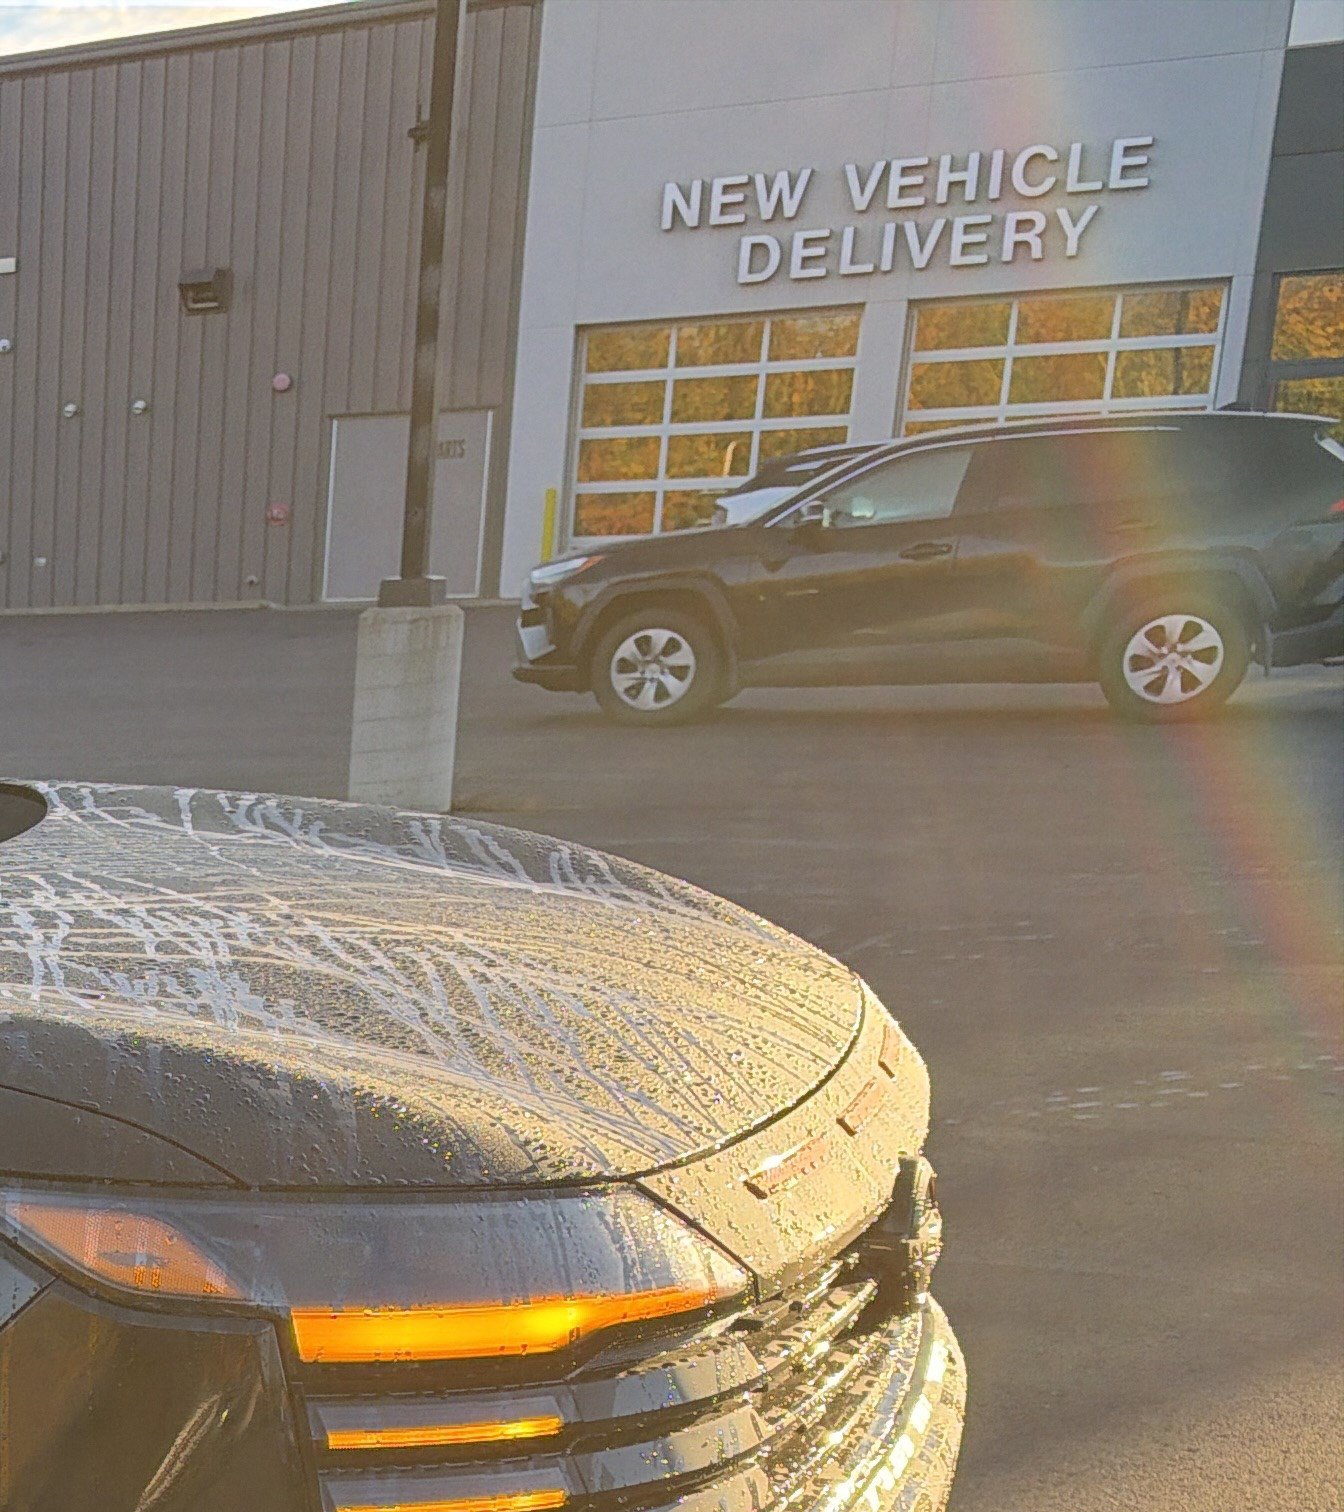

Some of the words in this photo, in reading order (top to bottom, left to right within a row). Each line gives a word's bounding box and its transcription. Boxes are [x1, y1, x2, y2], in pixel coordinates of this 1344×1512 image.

[660, 167, 812, 230] NEW
[845, 136, 1154, 212] VEHICLE
[736, 205, 1100, 284] DELIVERY
